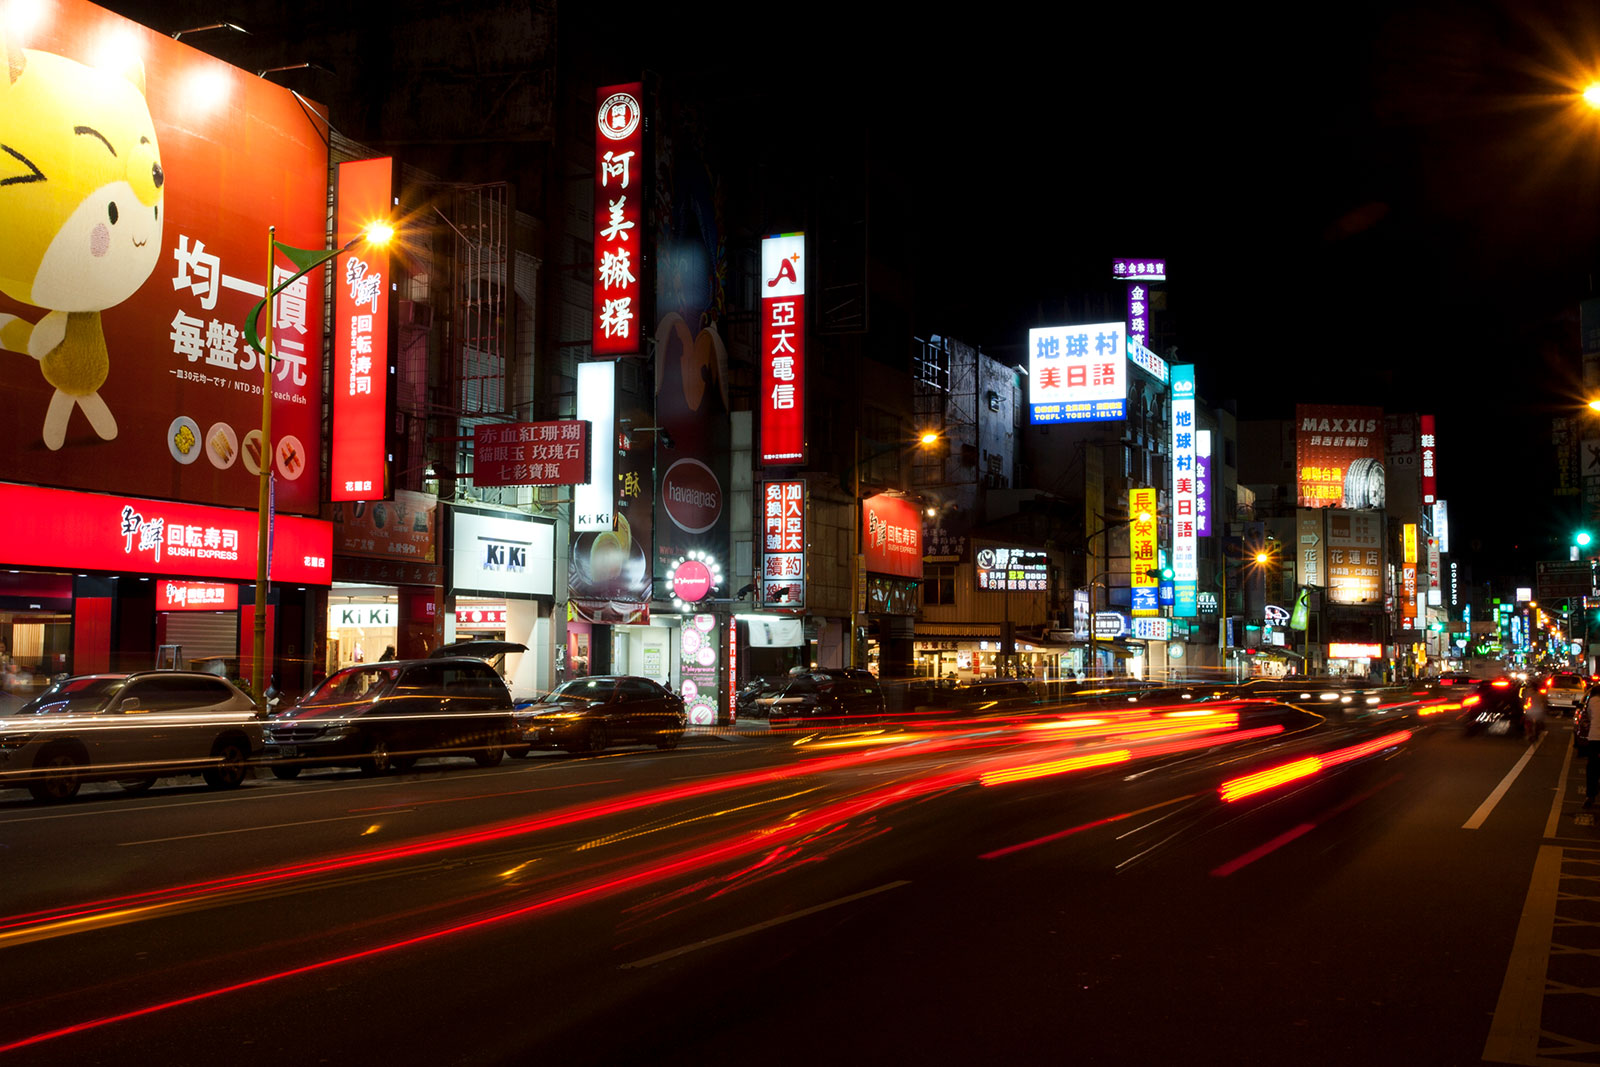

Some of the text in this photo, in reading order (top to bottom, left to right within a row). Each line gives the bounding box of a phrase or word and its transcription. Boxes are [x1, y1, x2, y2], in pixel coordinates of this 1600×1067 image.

[172, 234, 310, 335] 均一價
[771, 302, 796, 410] 亞太電信
[1036, 331, 1119, 359] 地球村
[1039, 363, 1115, 389] 美日語
[234, 381, 250, 393] NTD
[251, 384, 261, 395] 30
[274, 389, 291, 401] each
[292, 393, 307, 405] dish
[1034, 413, 1061, 421] TOEFL
[1065, 411, 1091, 419] TOEIC
[1301, 417, 1377, 433] MAXXIS
[480, 423, 581, 444] 赤血紅珊瑚
[480, 443, 580, 464] 貓眼玉 玫瑰石
[499, 463, 560, 481] 七彩寶瓶
[1176, 413, 1194, 538] 地球村美日語
[669, 480, 717, 509] havaianas
[766, 484, 782, 551] 免換門號
[786, 484, 802, 551] 加入亞太
[167, 547, 239, 562] SUSHI EXPRESS
[766, 556, 802, 577] 續約
[1330, 549, 1379, 566] 花蓮店
[1449, 562, 1458, 606] GIORDANO
